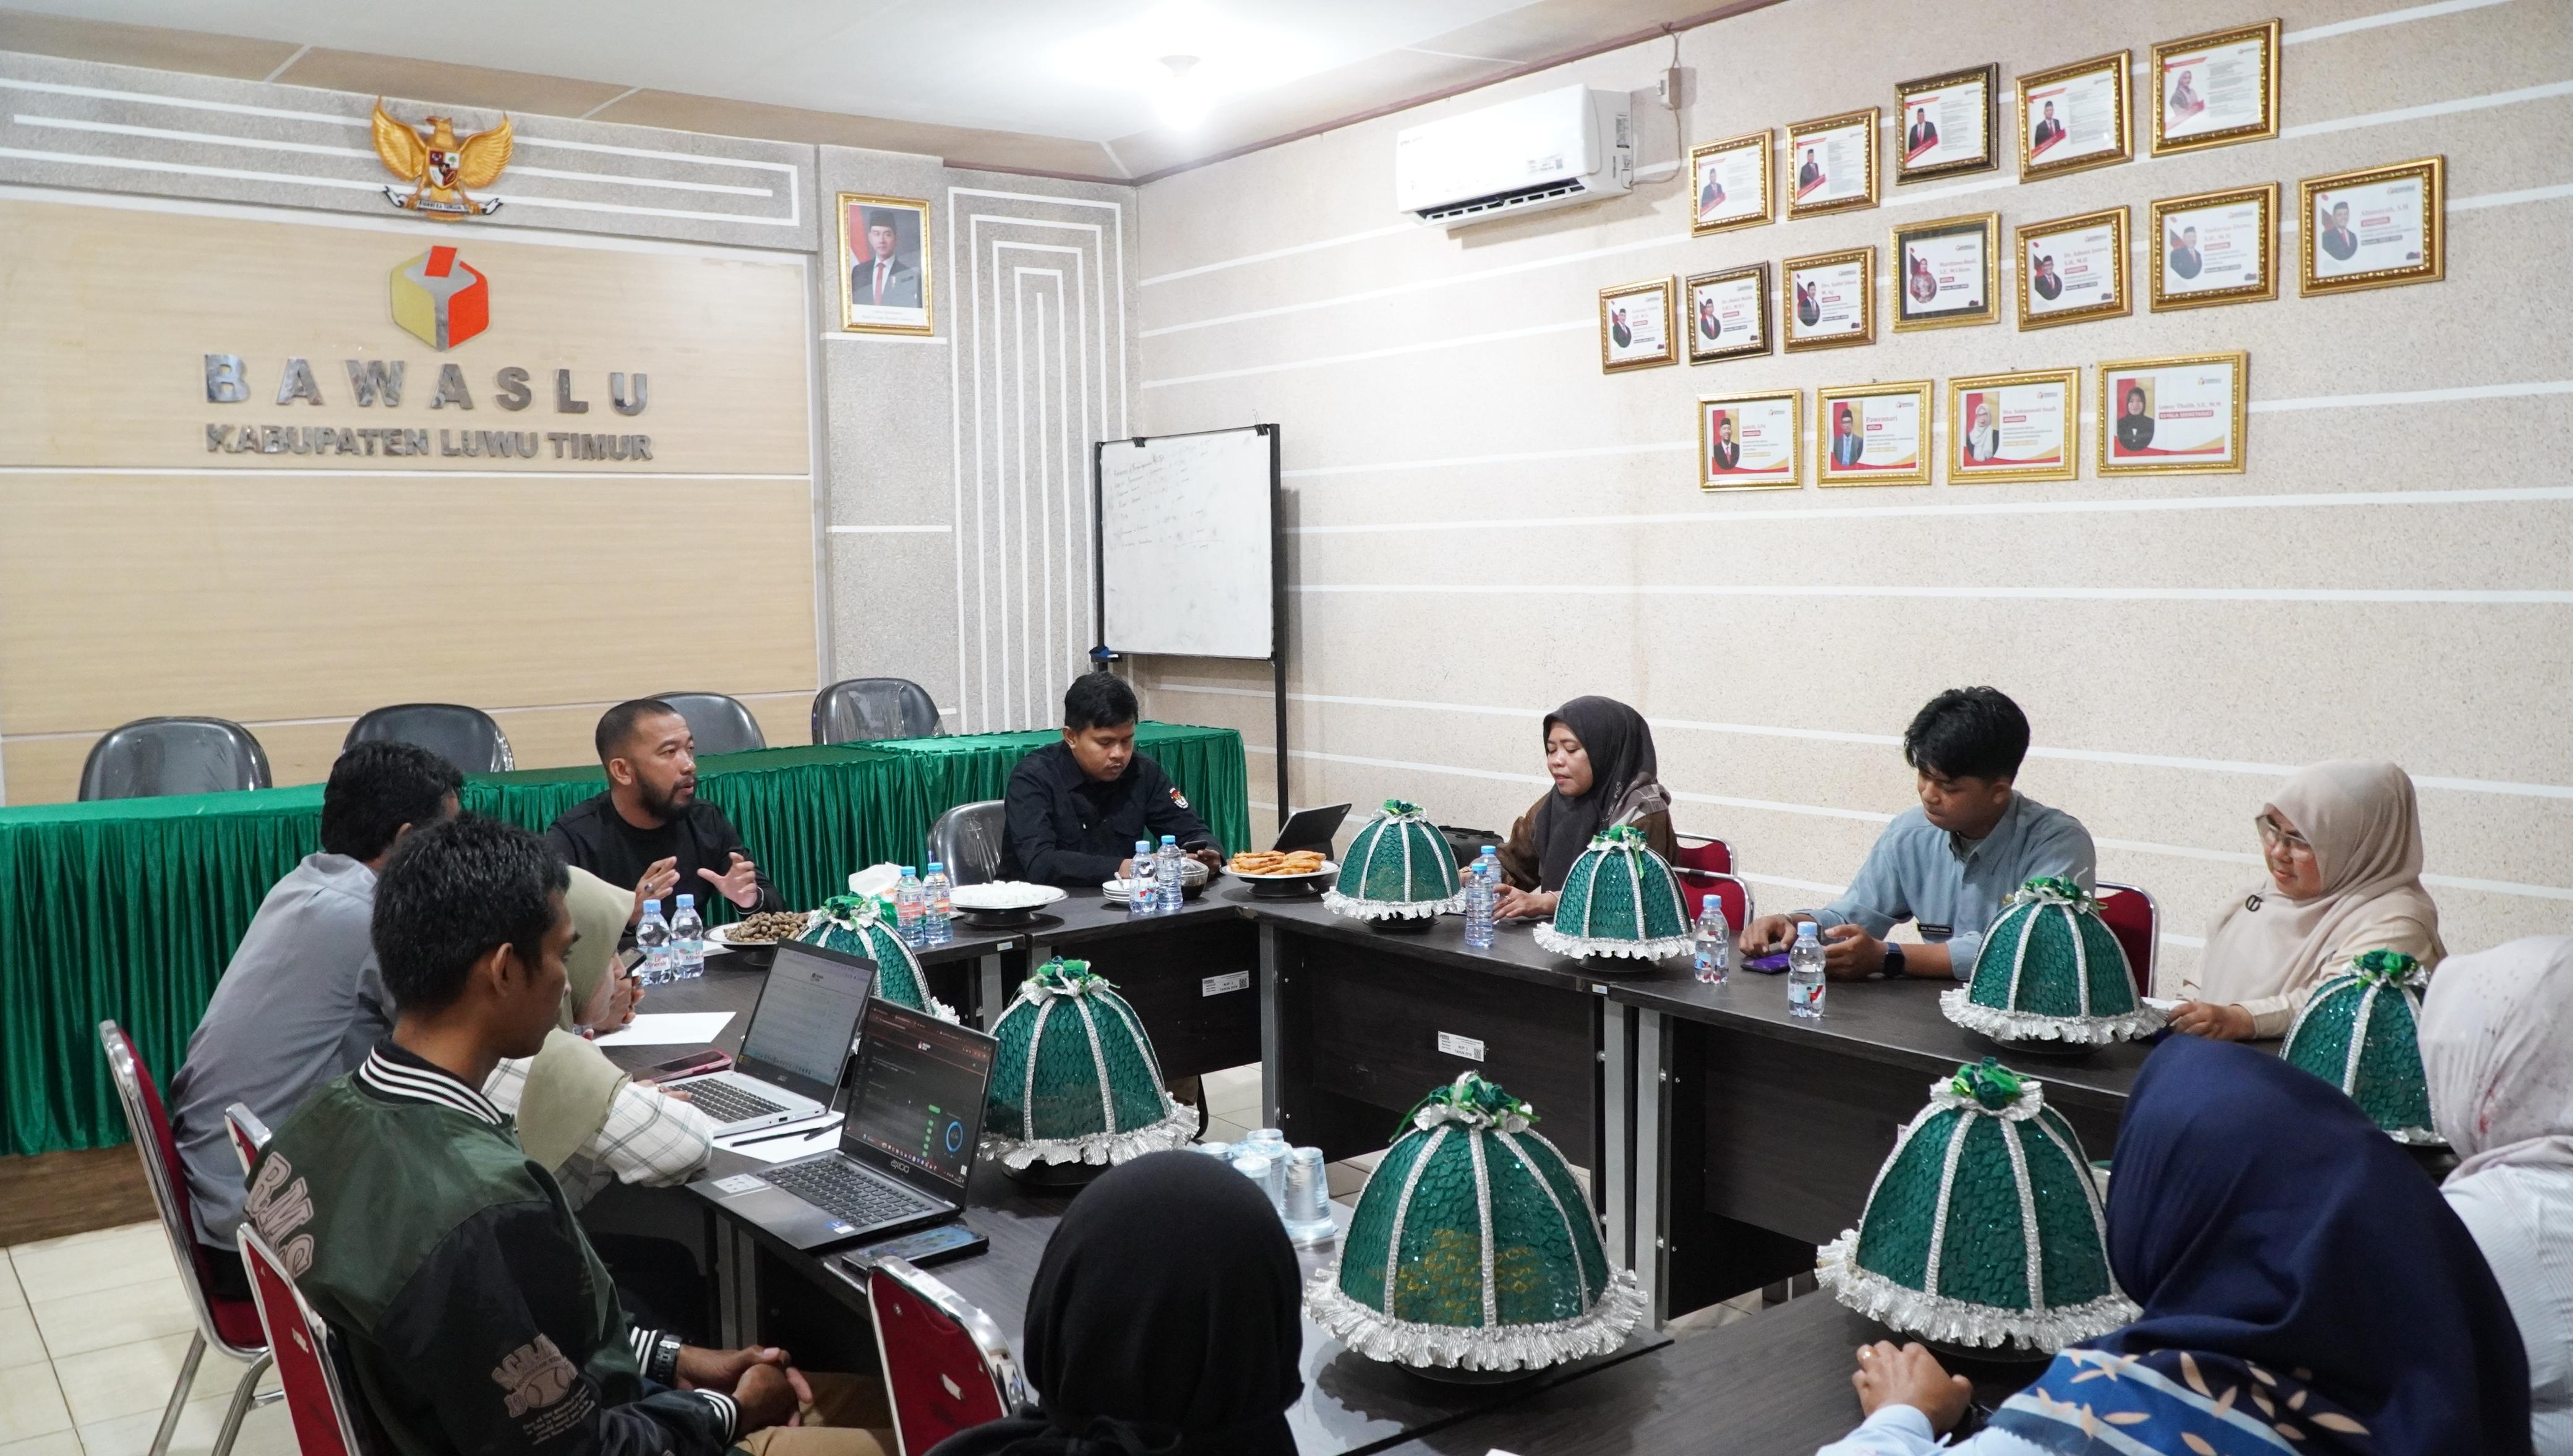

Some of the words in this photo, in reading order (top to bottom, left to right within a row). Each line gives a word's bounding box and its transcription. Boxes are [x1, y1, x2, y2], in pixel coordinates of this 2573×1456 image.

[203, 353, 648, 416] BAWASLU
[205, 423, 429, 456] KABUPATEN
[440, 429, 539, 459] LUWU
[547, 432, 654, 461] TIMUR
